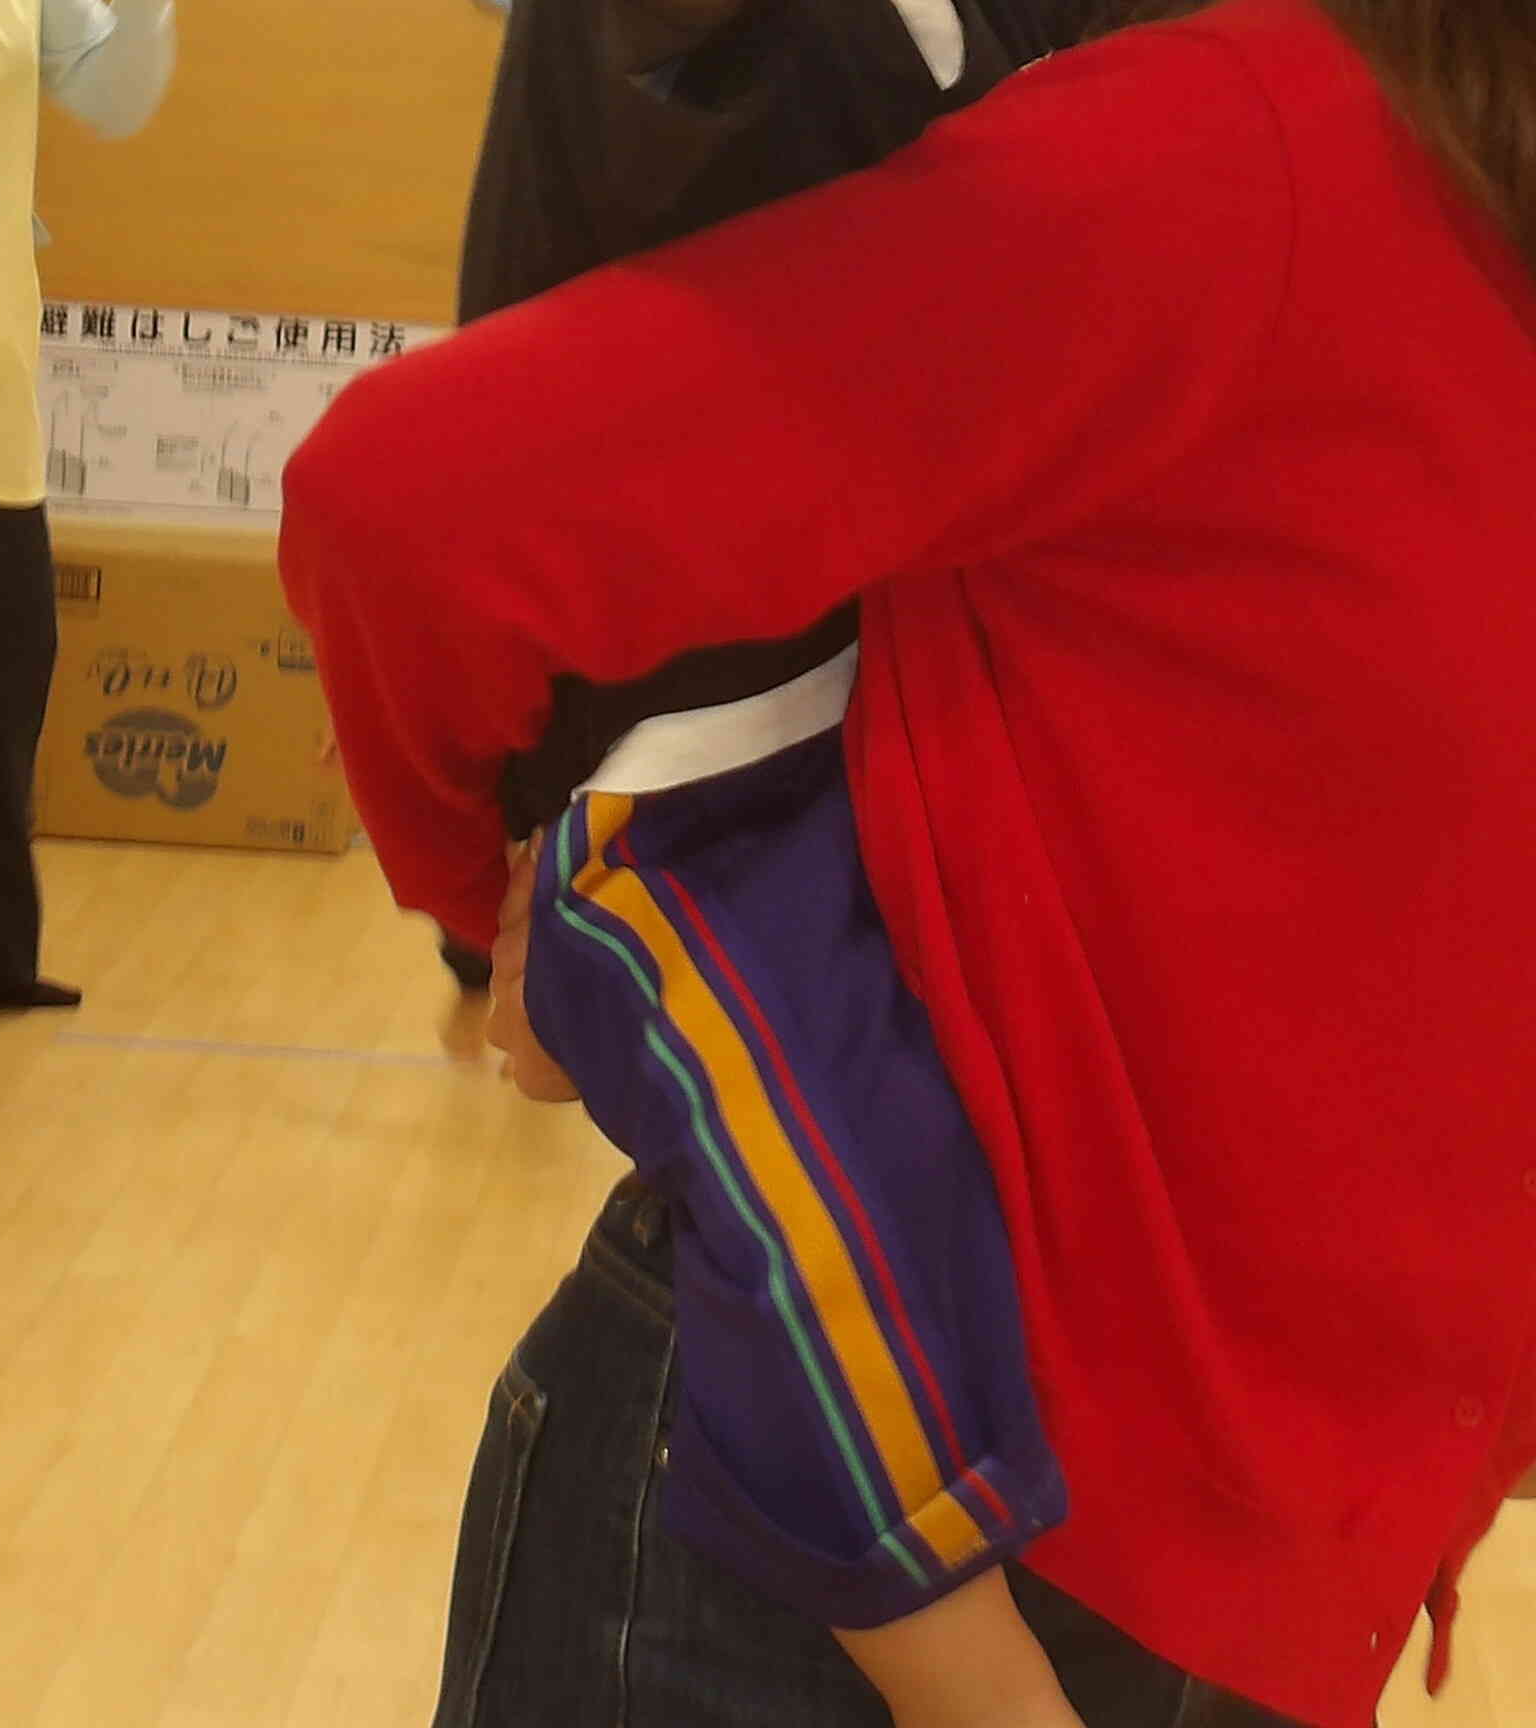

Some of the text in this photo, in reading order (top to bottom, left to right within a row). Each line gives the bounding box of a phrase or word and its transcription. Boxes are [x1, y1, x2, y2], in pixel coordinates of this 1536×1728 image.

[40, 304, 406, 358] 避難はしご使用法
